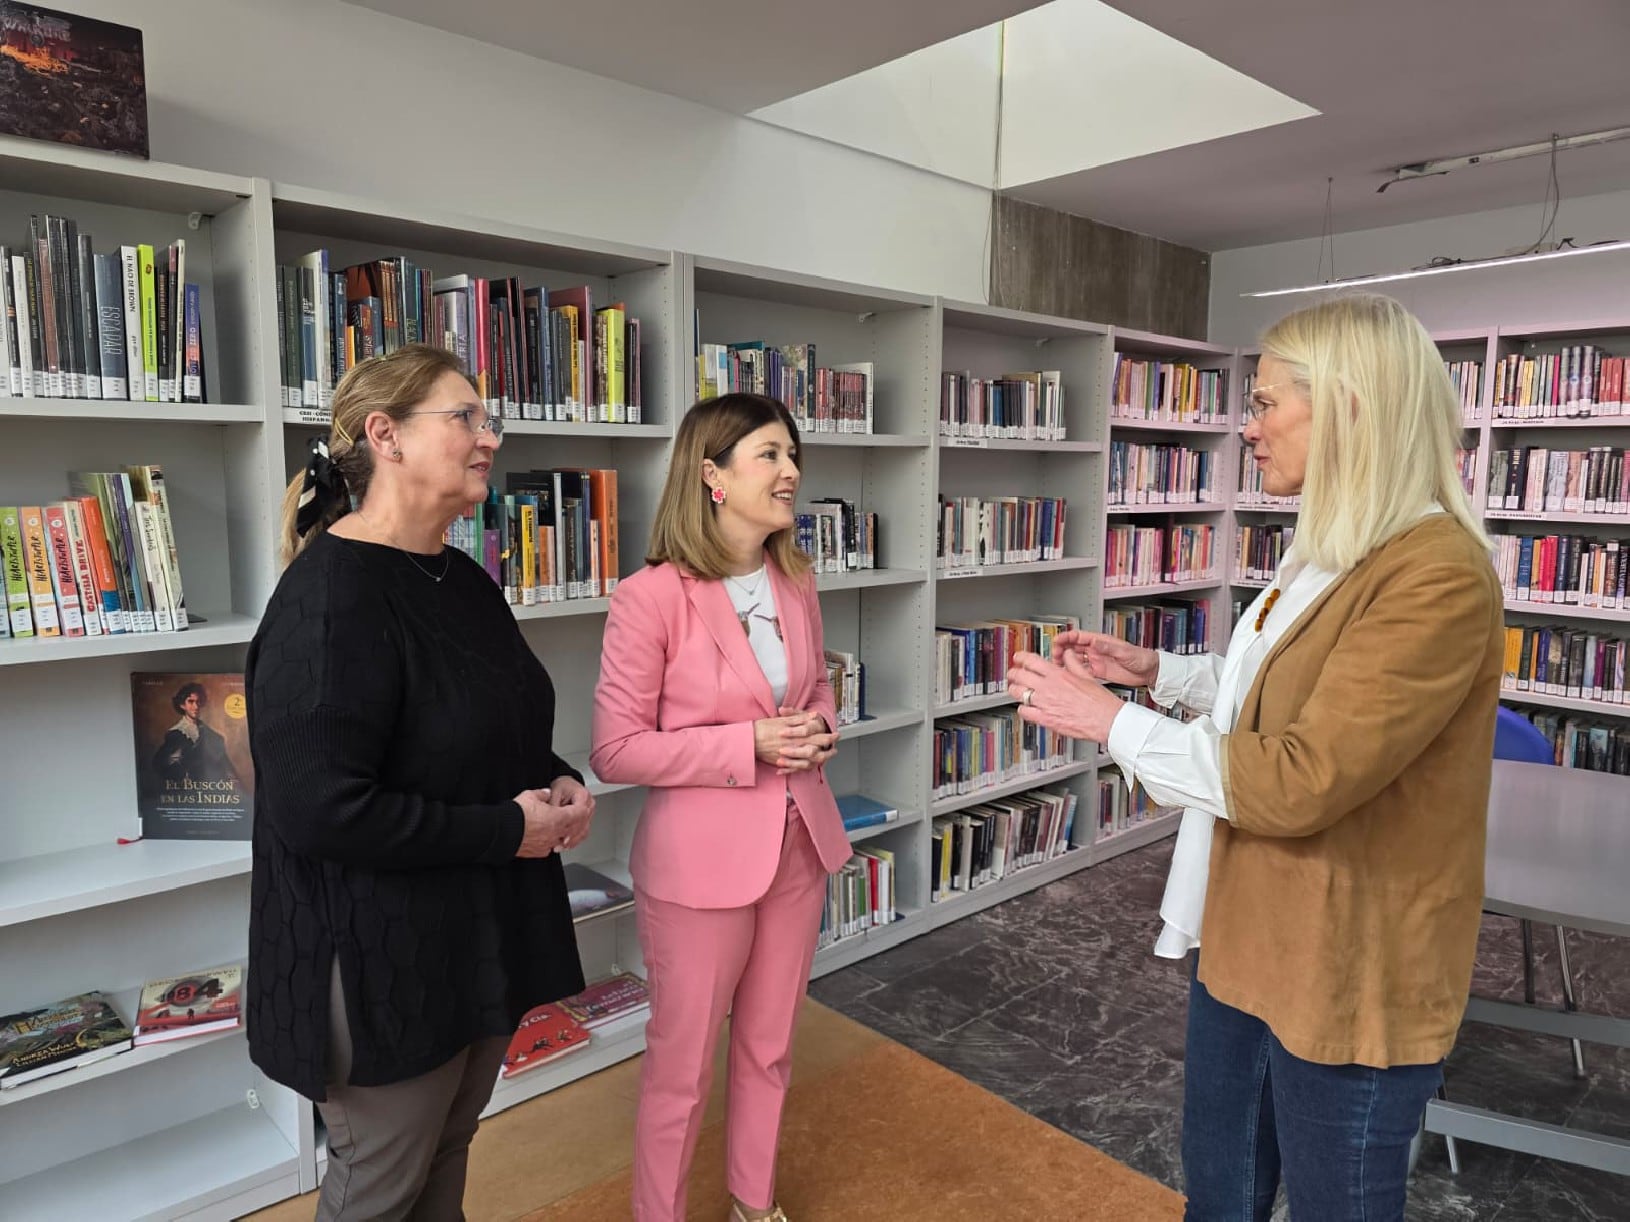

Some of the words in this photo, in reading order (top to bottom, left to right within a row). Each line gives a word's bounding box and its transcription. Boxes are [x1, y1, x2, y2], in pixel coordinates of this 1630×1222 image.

[100, 306, 122, 355] ESCAPAR
[166, 779, 180, 790] EL
[183, 777, 233, 790] BUSCÓN
[178, 795, 196, 804] LAS
[197, 791, 240, 804] INDIAS
